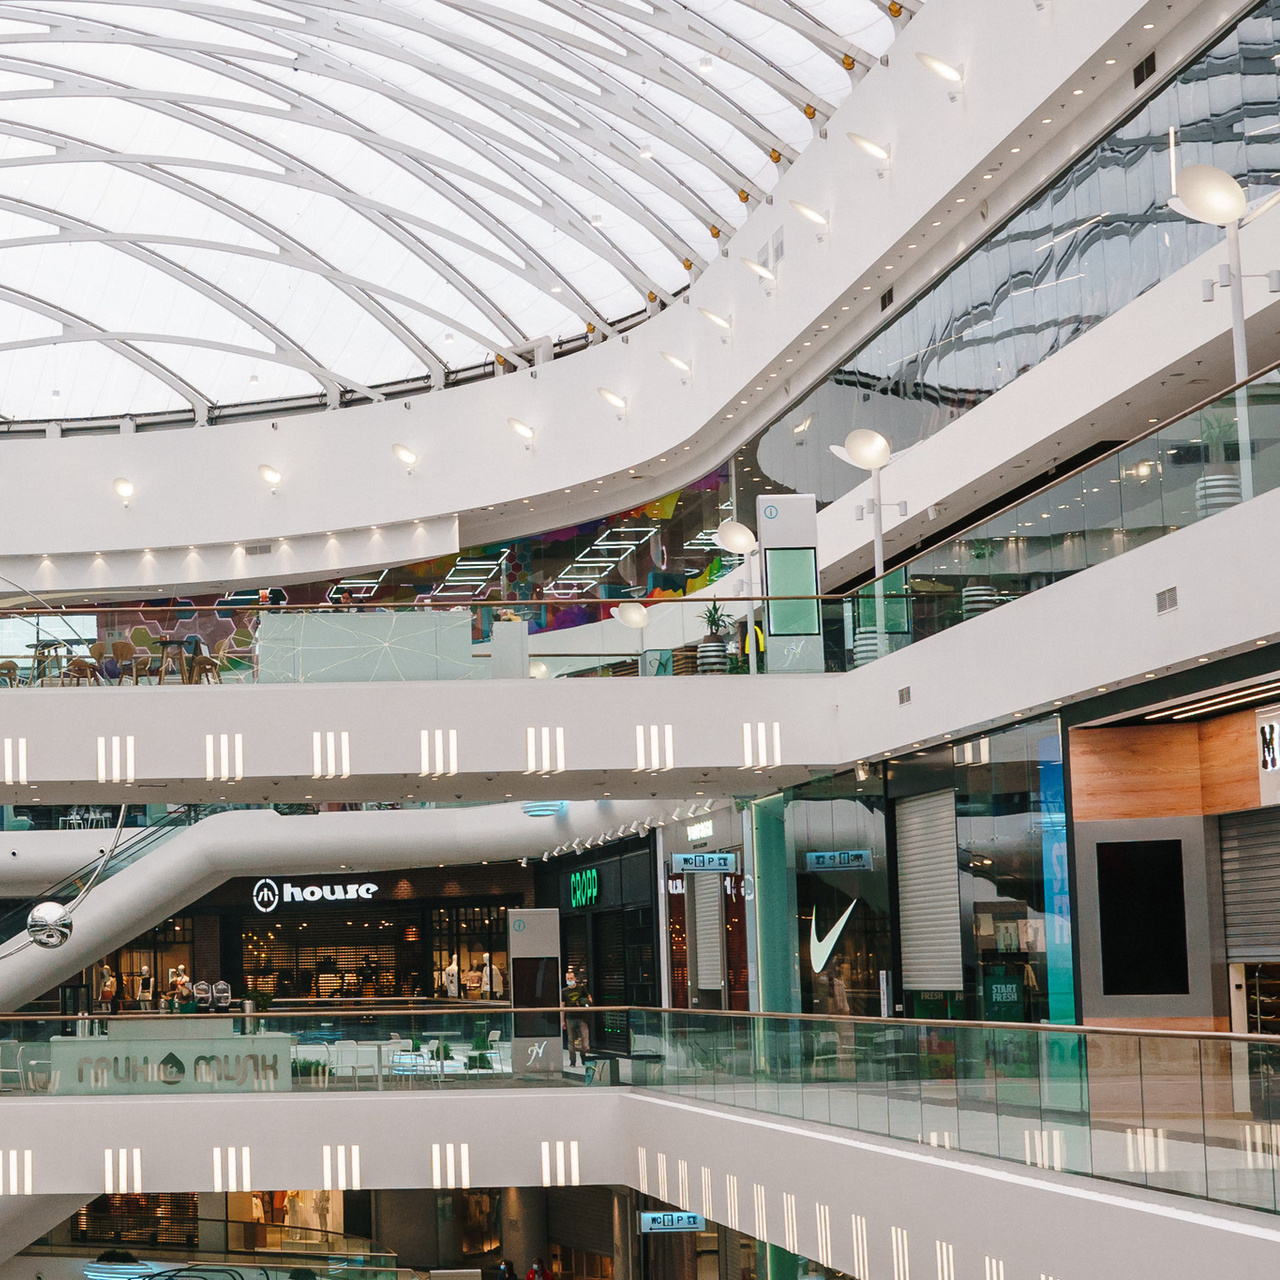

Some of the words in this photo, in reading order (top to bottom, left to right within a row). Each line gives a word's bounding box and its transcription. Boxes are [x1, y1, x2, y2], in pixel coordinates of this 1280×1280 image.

[683, 857, 694, 866] WC
[707, 857, 715, 866] P
[283, 882, 379, 902] house
[570, 868, 598, 908] CROPP
[991, 984, 1017, 993] START
[920, 991, 944, 1000] FRESH
[992, 993, 1018, 1002] FRESH
[651, 1216, 662, 1224] WC
[676, 1216, 684, 1224] P
